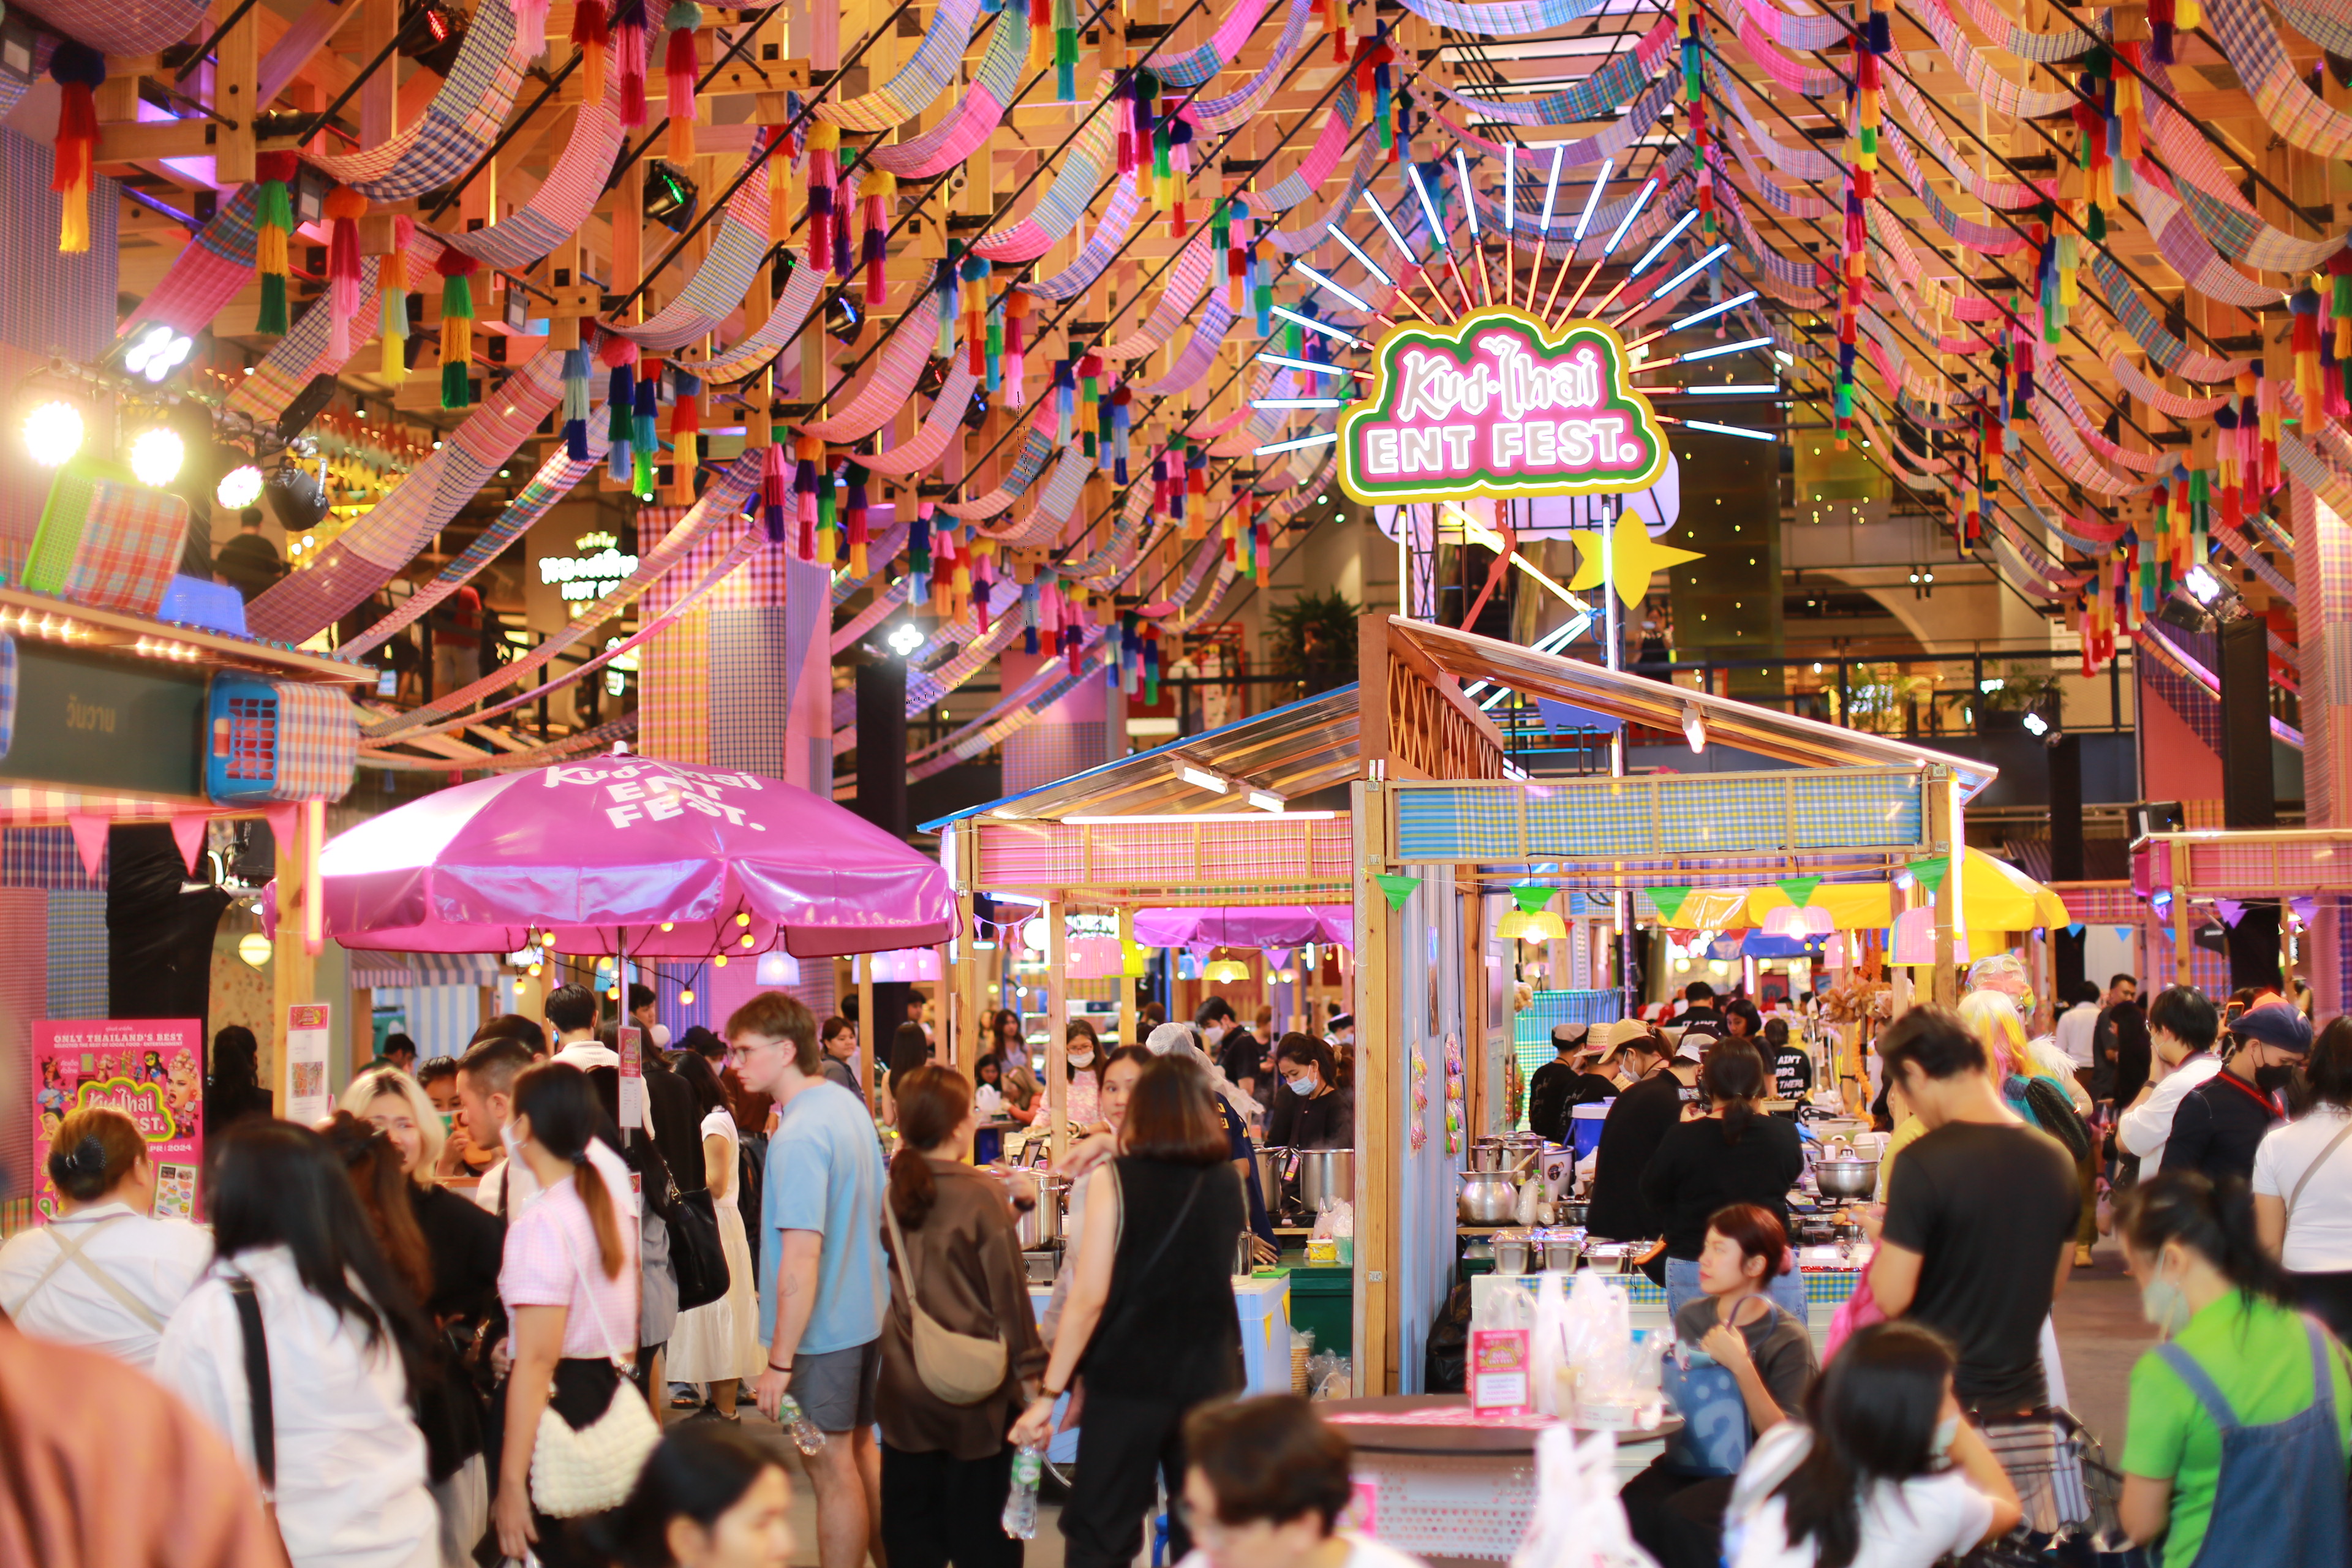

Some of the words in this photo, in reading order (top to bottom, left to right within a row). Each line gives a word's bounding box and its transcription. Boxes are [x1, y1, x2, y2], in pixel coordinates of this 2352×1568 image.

[1366, 424, 1476, 474] ENT
[1493, 418, 1638, 468] FEST.
[606, 775, 723, 803] ENT
[606, 791, 766, 831] FEST.
[156, 1033, 183, 1042] BEST
